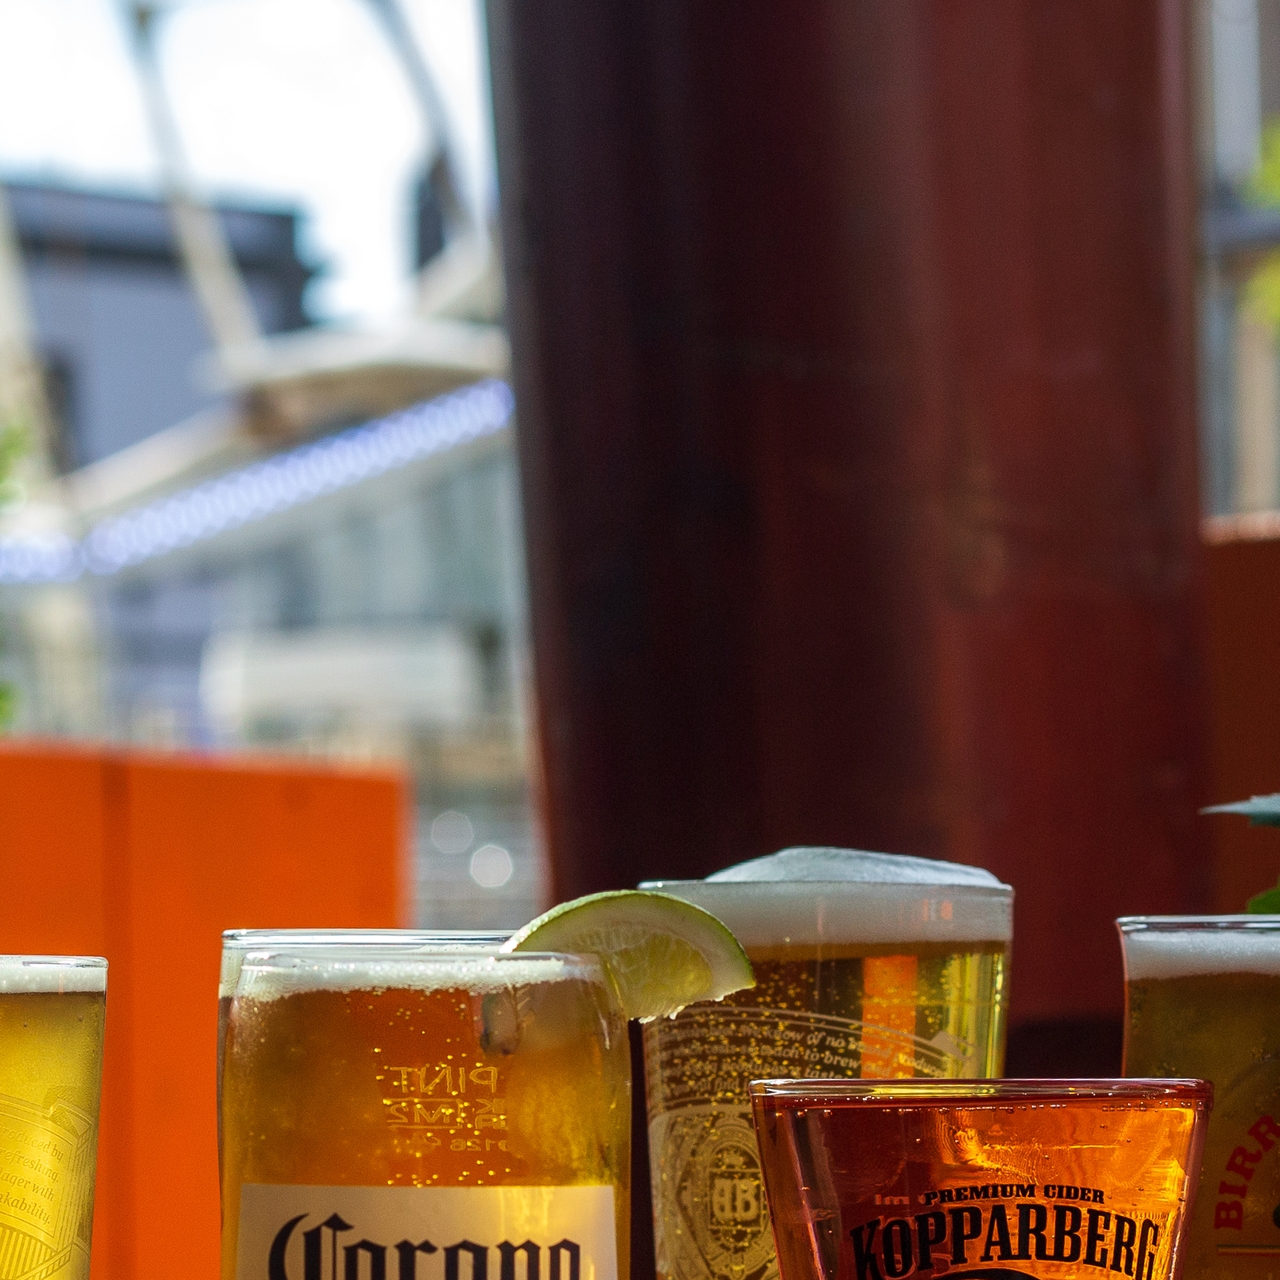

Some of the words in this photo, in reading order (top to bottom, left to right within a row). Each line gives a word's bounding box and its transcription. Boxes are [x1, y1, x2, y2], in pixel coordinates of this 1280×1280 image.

[807, 1031, 822, 1045] of
[52, 1144, 65, 1163] by
[32, 1182, 55, 1202] with
[925, 1183, 1036, 1207] PREMIUM
[1043, 1183, 1105, 1205] CIDER
